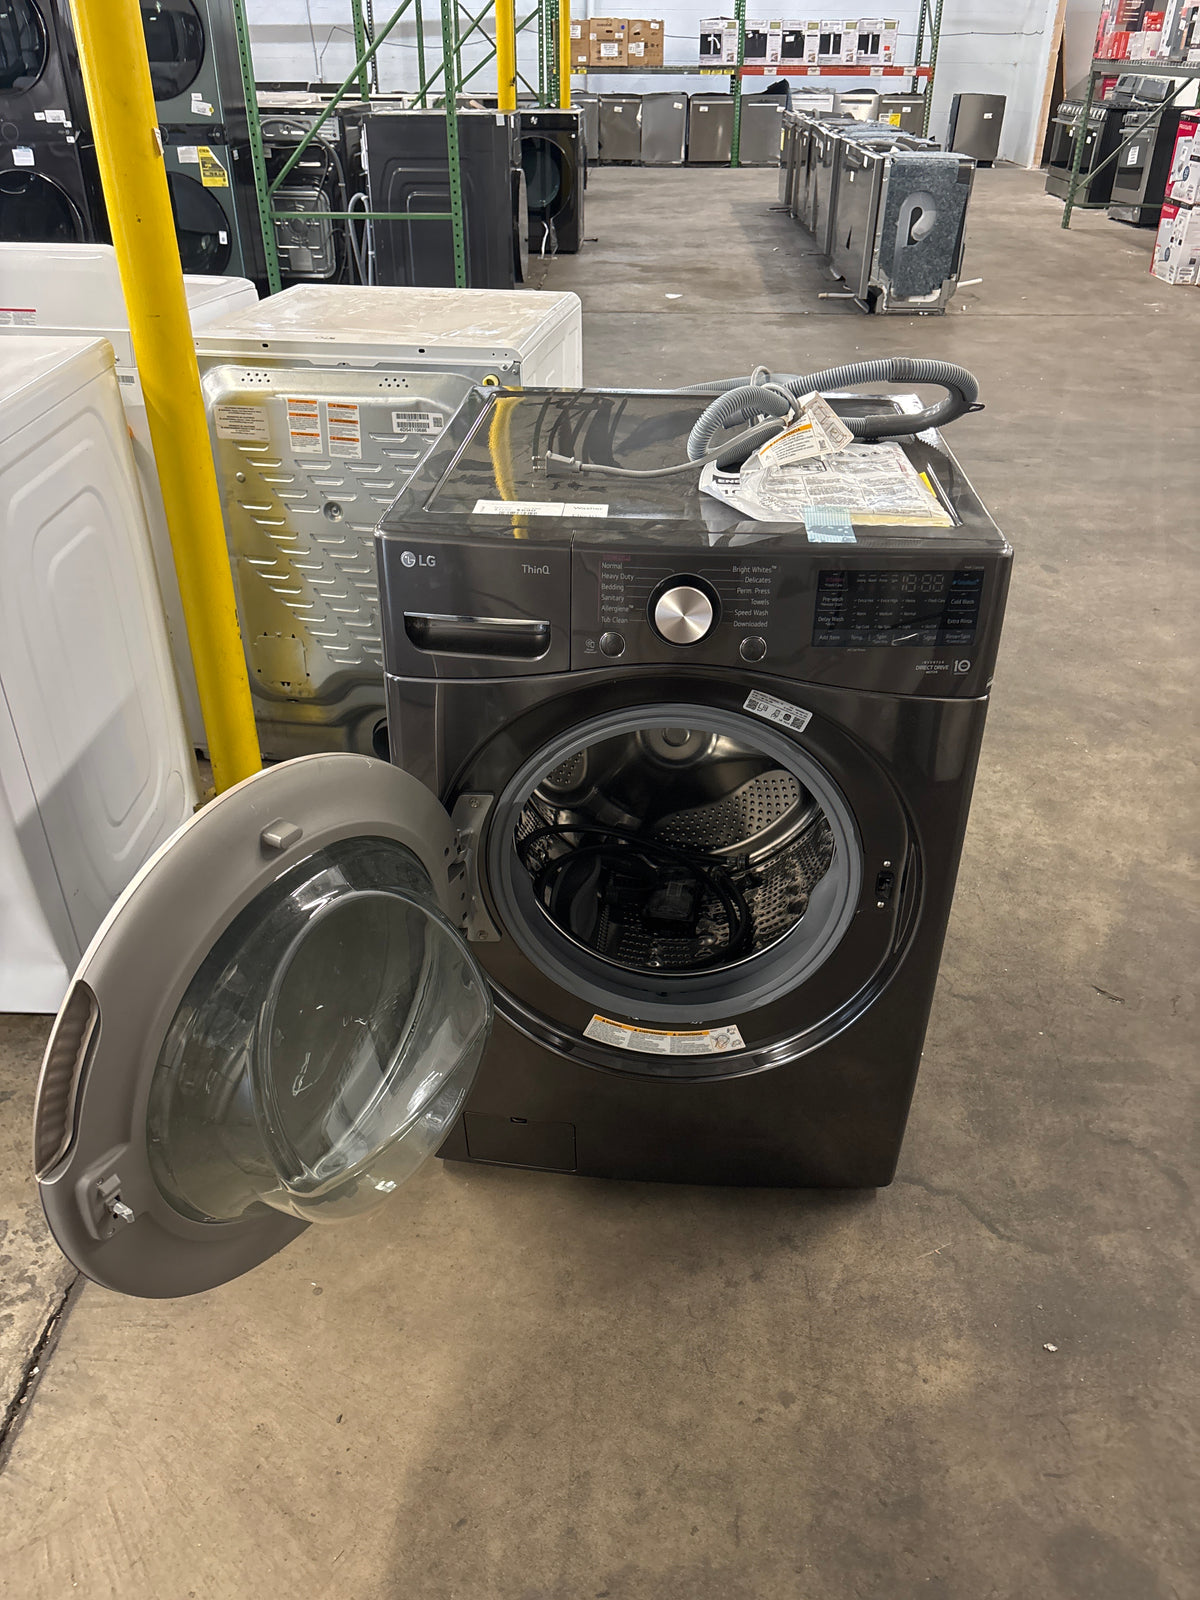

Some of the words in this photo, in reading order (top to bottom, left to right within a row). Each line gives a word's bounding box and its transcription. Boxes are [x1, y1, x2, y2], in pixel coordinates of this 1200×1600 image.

[418, 554, 436, 567] LG
[521, 564, 551, 575] ThinQ
[732, 565, 750, 574] Bright
[601, 572, 619, 581] Heavy
[620, 573, 635, 581] Duty
[744, 576, 772, 584] Delicates
[601, 583, 625, 592] Bedding
[754, 587, 770, 595] Press
[600, 593, 625, 603] Sanitary
[751, 598, 770, 606] Towels
[734, 609, 752, 617] Speed
[612, 616, 628, 624] Clean
[733, 620, 768, 628] Downloaded
